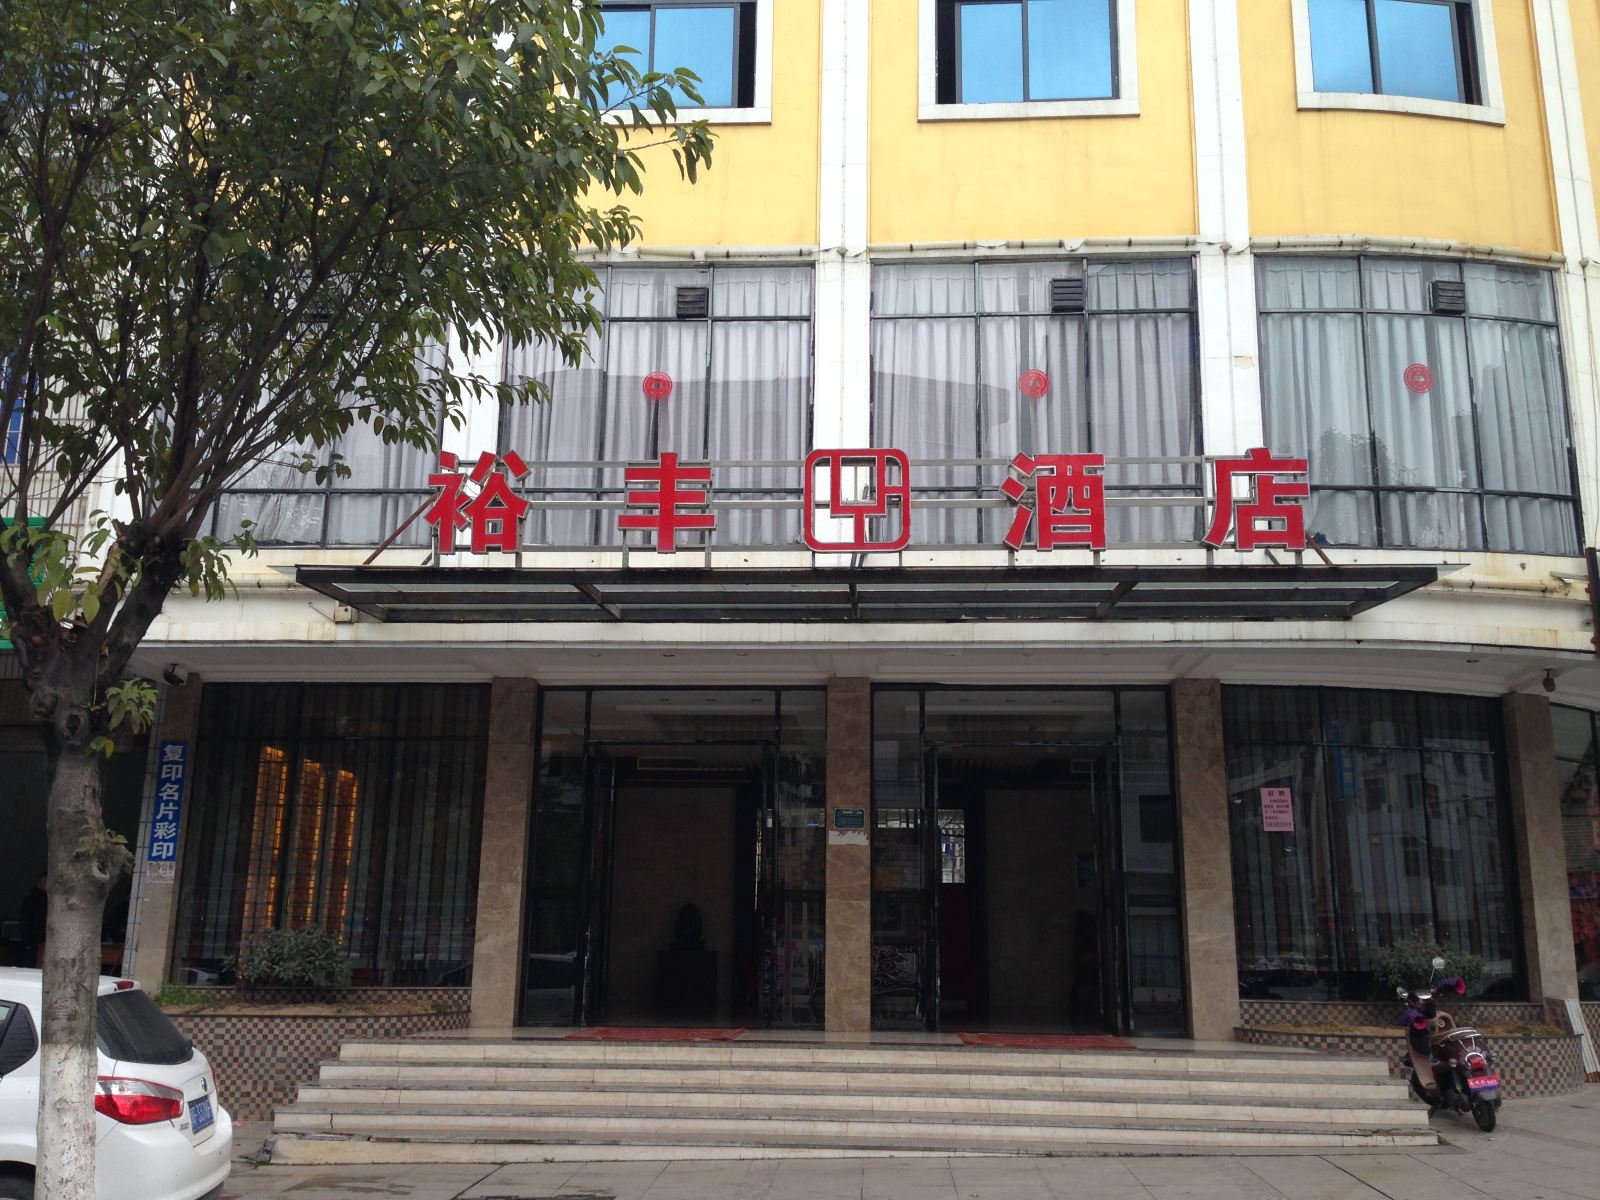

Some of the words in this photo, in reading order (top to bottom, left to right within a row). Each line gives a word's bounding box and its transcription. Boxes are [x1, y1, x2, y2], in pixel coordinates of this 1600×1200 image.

[151, 744, 184, 859] 复印名片彩印
